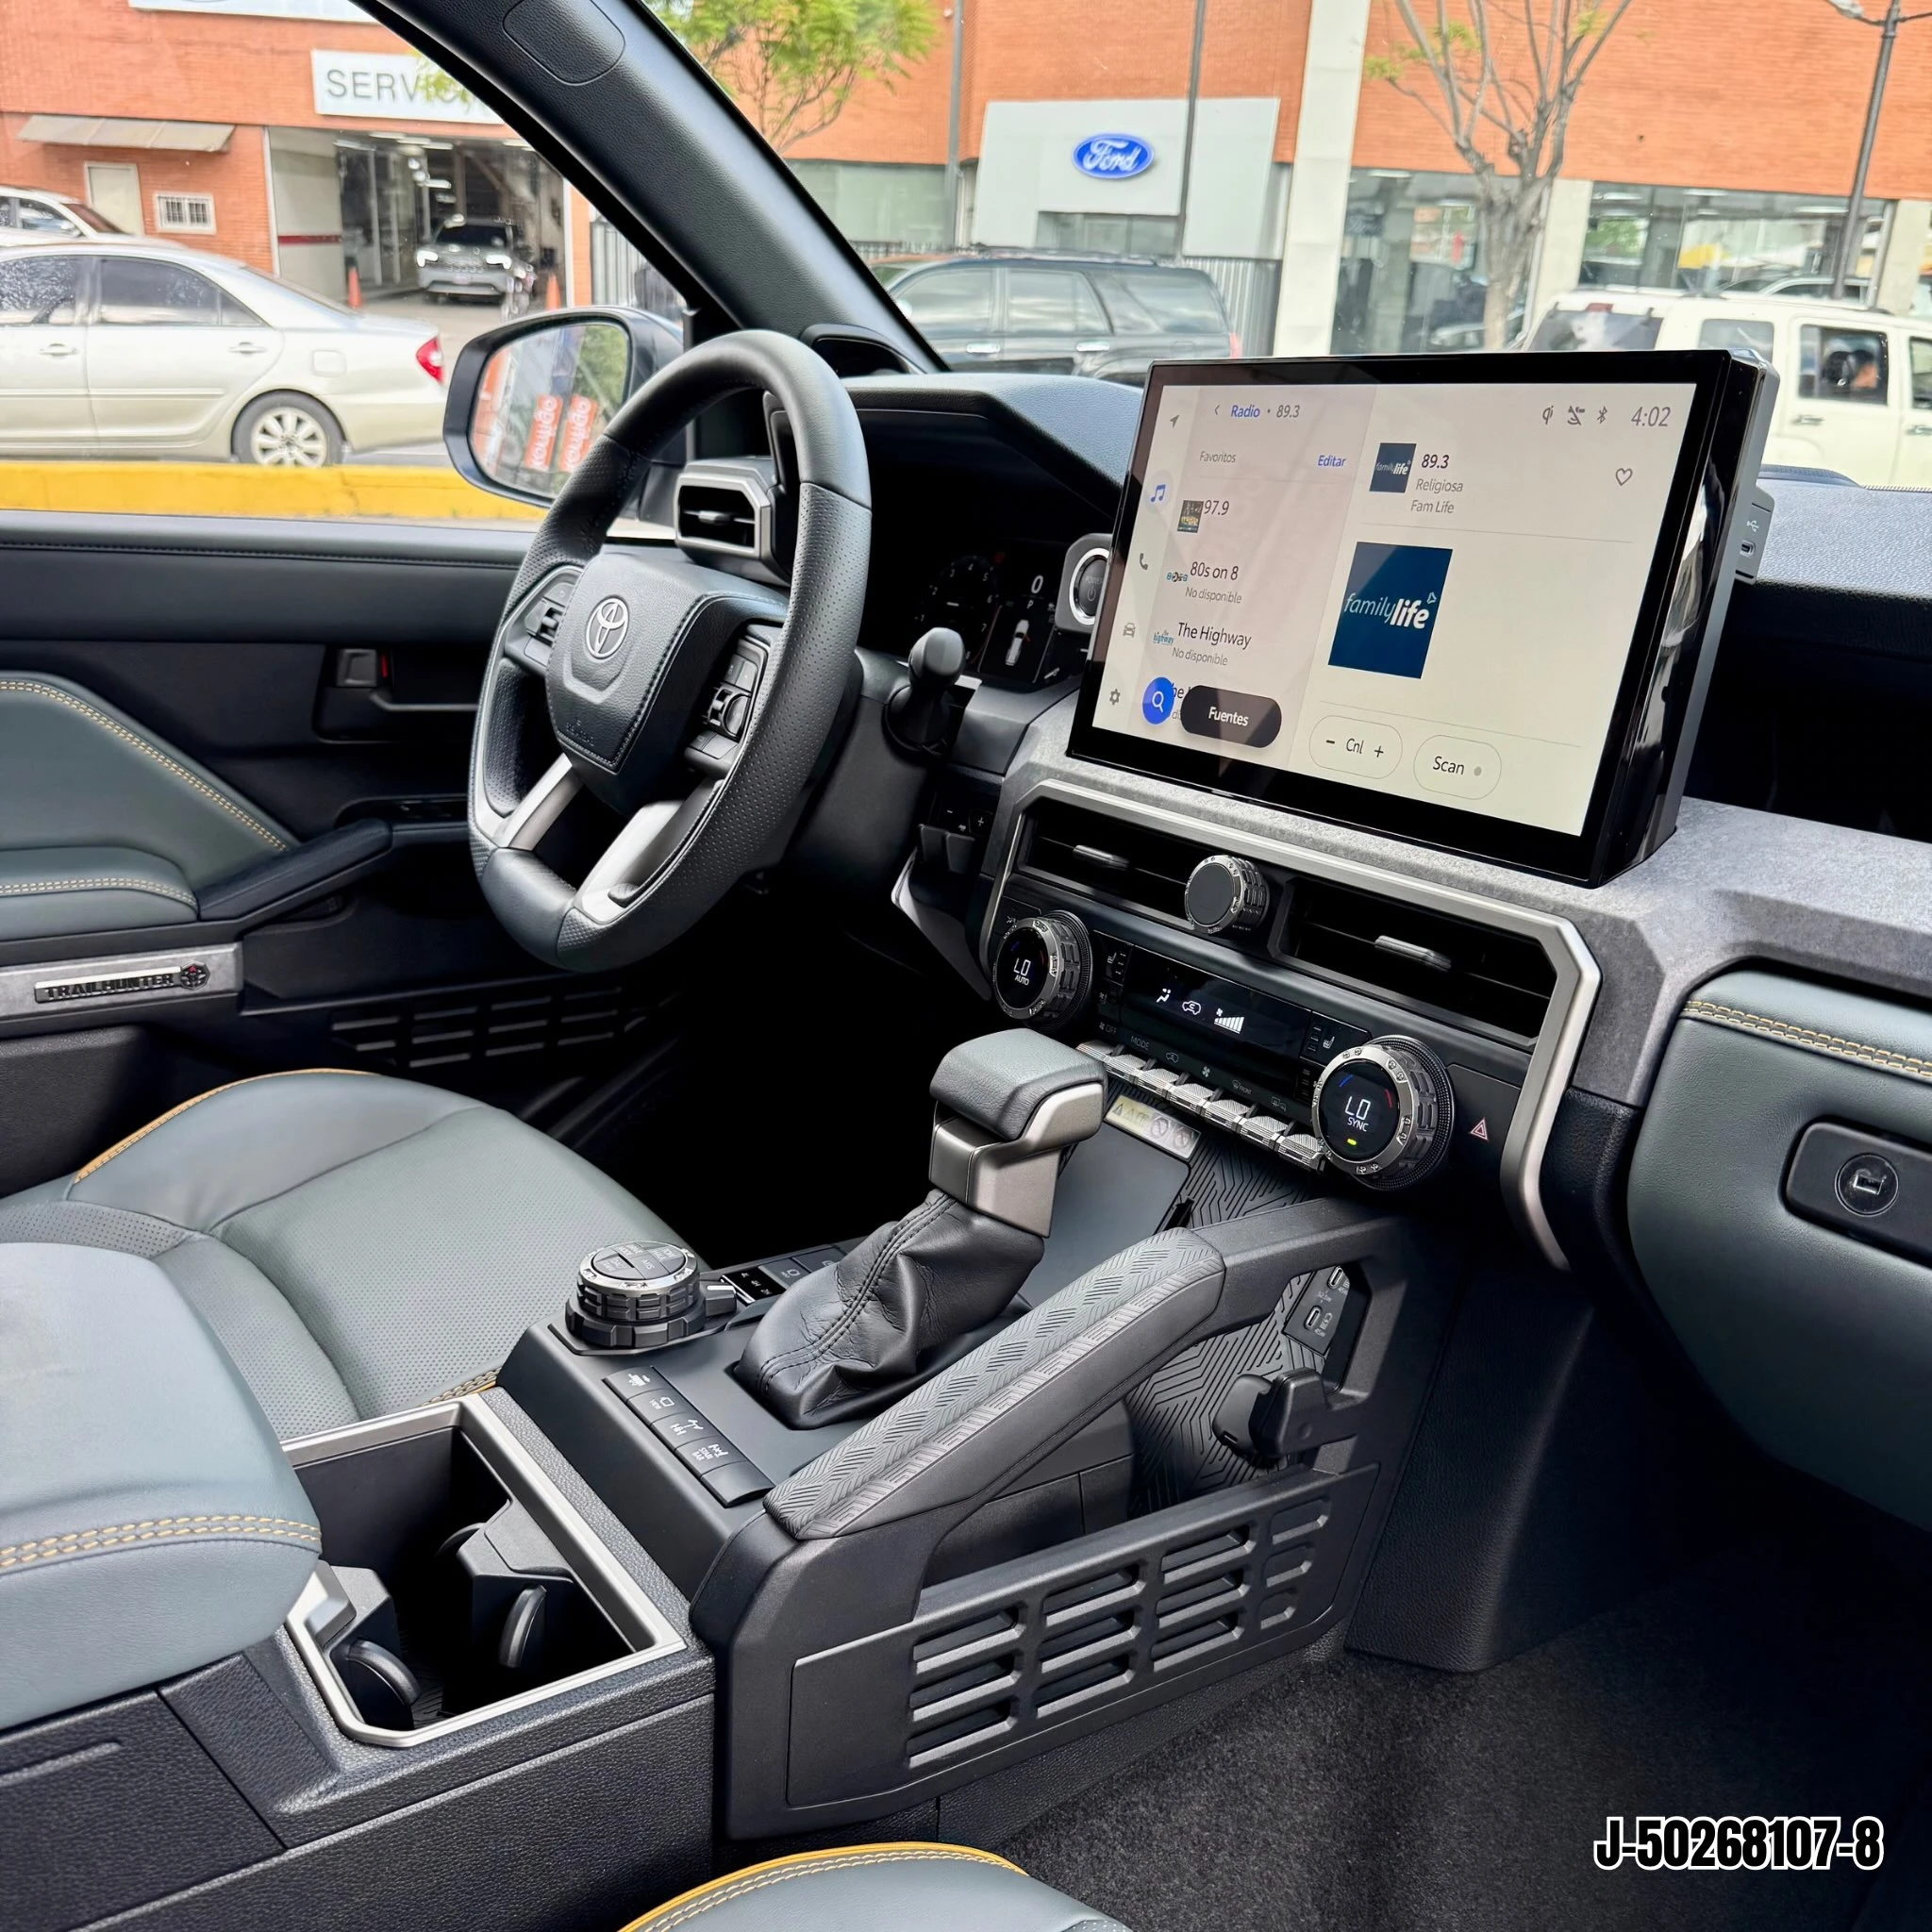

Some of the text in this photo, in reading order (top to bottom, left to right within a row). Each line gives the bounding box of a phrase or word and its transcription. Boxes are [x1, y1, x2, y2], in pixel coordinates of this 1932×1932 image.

[1083, 140, 1142, 171] Ford
[1230, 404, 1301, 419] Radio 89.3
[1630, 407, 1671, 426] 4:02
[1199, 451, 1237, 463] Favoritos
[1317, 455, 1347, 467] Editar
[1421, 454, 1450, 469] 89.3
[1415, 478, 1463, 494] Religiosa
[1204, 500, 1230, 515] 97.9
[1410, 500, 1455, 514] Fam Life
[1190, 561, 1210, 577] 80s
[1212, 567, 1227, 579] on
[1230, 566, 1239, 580] 8
[1031, 575, 1043, 593] 0
[1026, 600, 1034, 608] P
[1185, 587, 1242, 605] No disponible
[1344, 592, 1430, 629] familylife
[1178, 622, 1252, 650] The Highway
[1172, 647, 1228, 666] No disponible
[1208, 706, 1249, 726] Fuentes
[1345, 738, 1364, 754] Cnl
[1432, 756, 1465, 775] Scan
[44, 973, 175, 999] TRAILHUNTER
[1014, 974, 1030, 986] AUTO
[1106, 1024, 1117, 1035] OFF
[1130, 1036, 1150, 1050] MODE
[1347, 1117, 1369, 1132] SYNC
